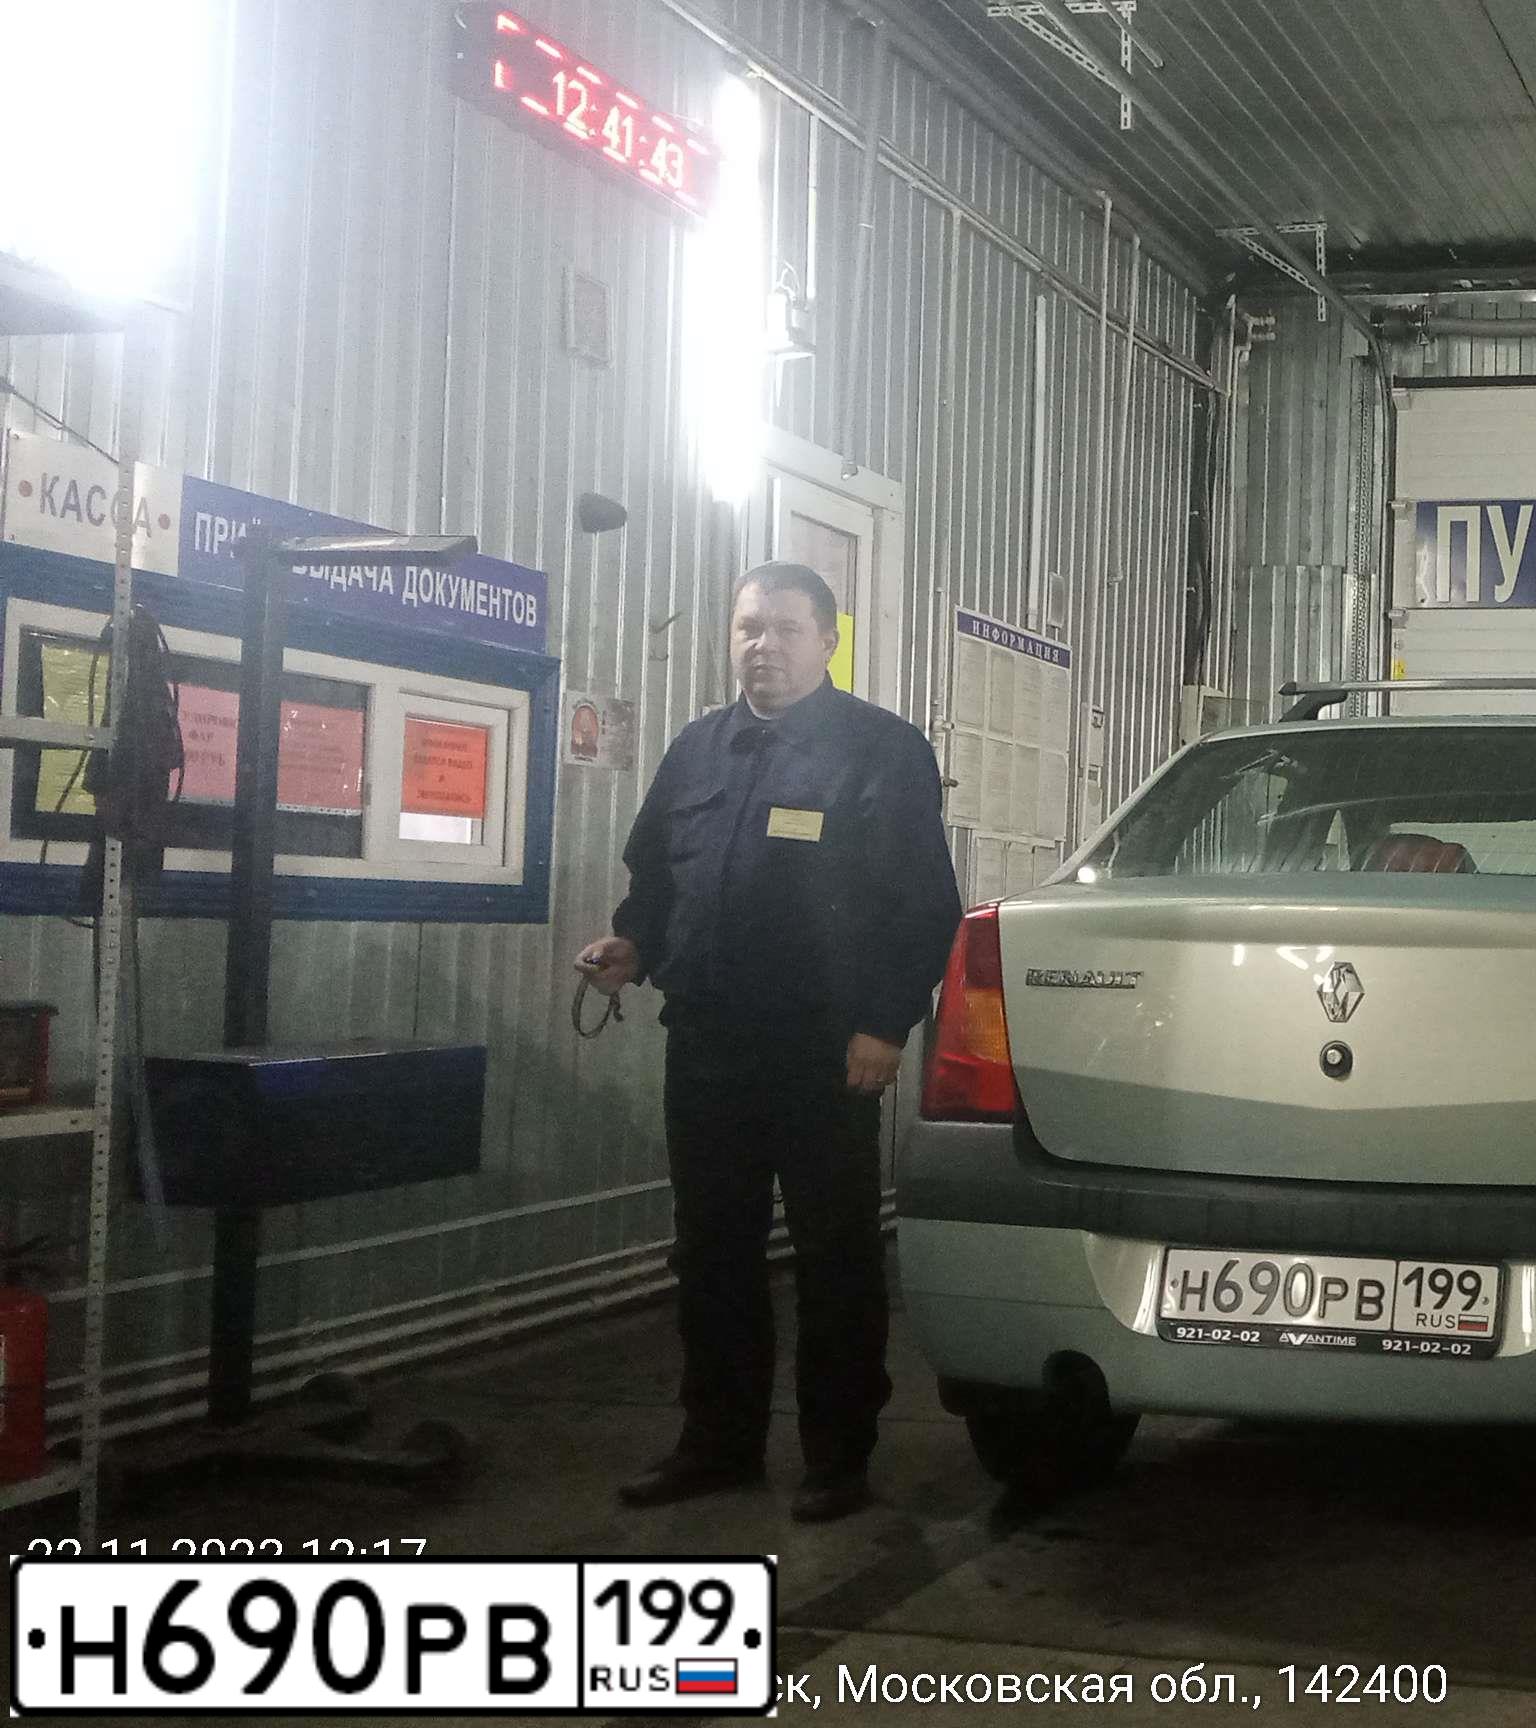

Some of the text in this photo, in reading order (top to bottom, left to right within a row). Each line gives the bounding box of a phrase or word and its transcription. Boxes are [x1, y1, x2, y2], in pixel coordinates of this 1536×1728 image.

[552, 70, 684, 189] 12:41:43
[292, 564, 394, 595] ДАЧА
[402, 565, 538, 628] ДОКУМЕНТОВ
[972, 620, 1061, 663] ИНФОРМАЦИЯ
[1026, 968, 1144, 989] RENAULT
[1179, 1259, 1482, 1322] Н690РВ 199
[1176, 1326, 1472, 1356] 921-02-02 AVANTIME 921-02-02
[1416, 1313, 1456, 1329] RUS
